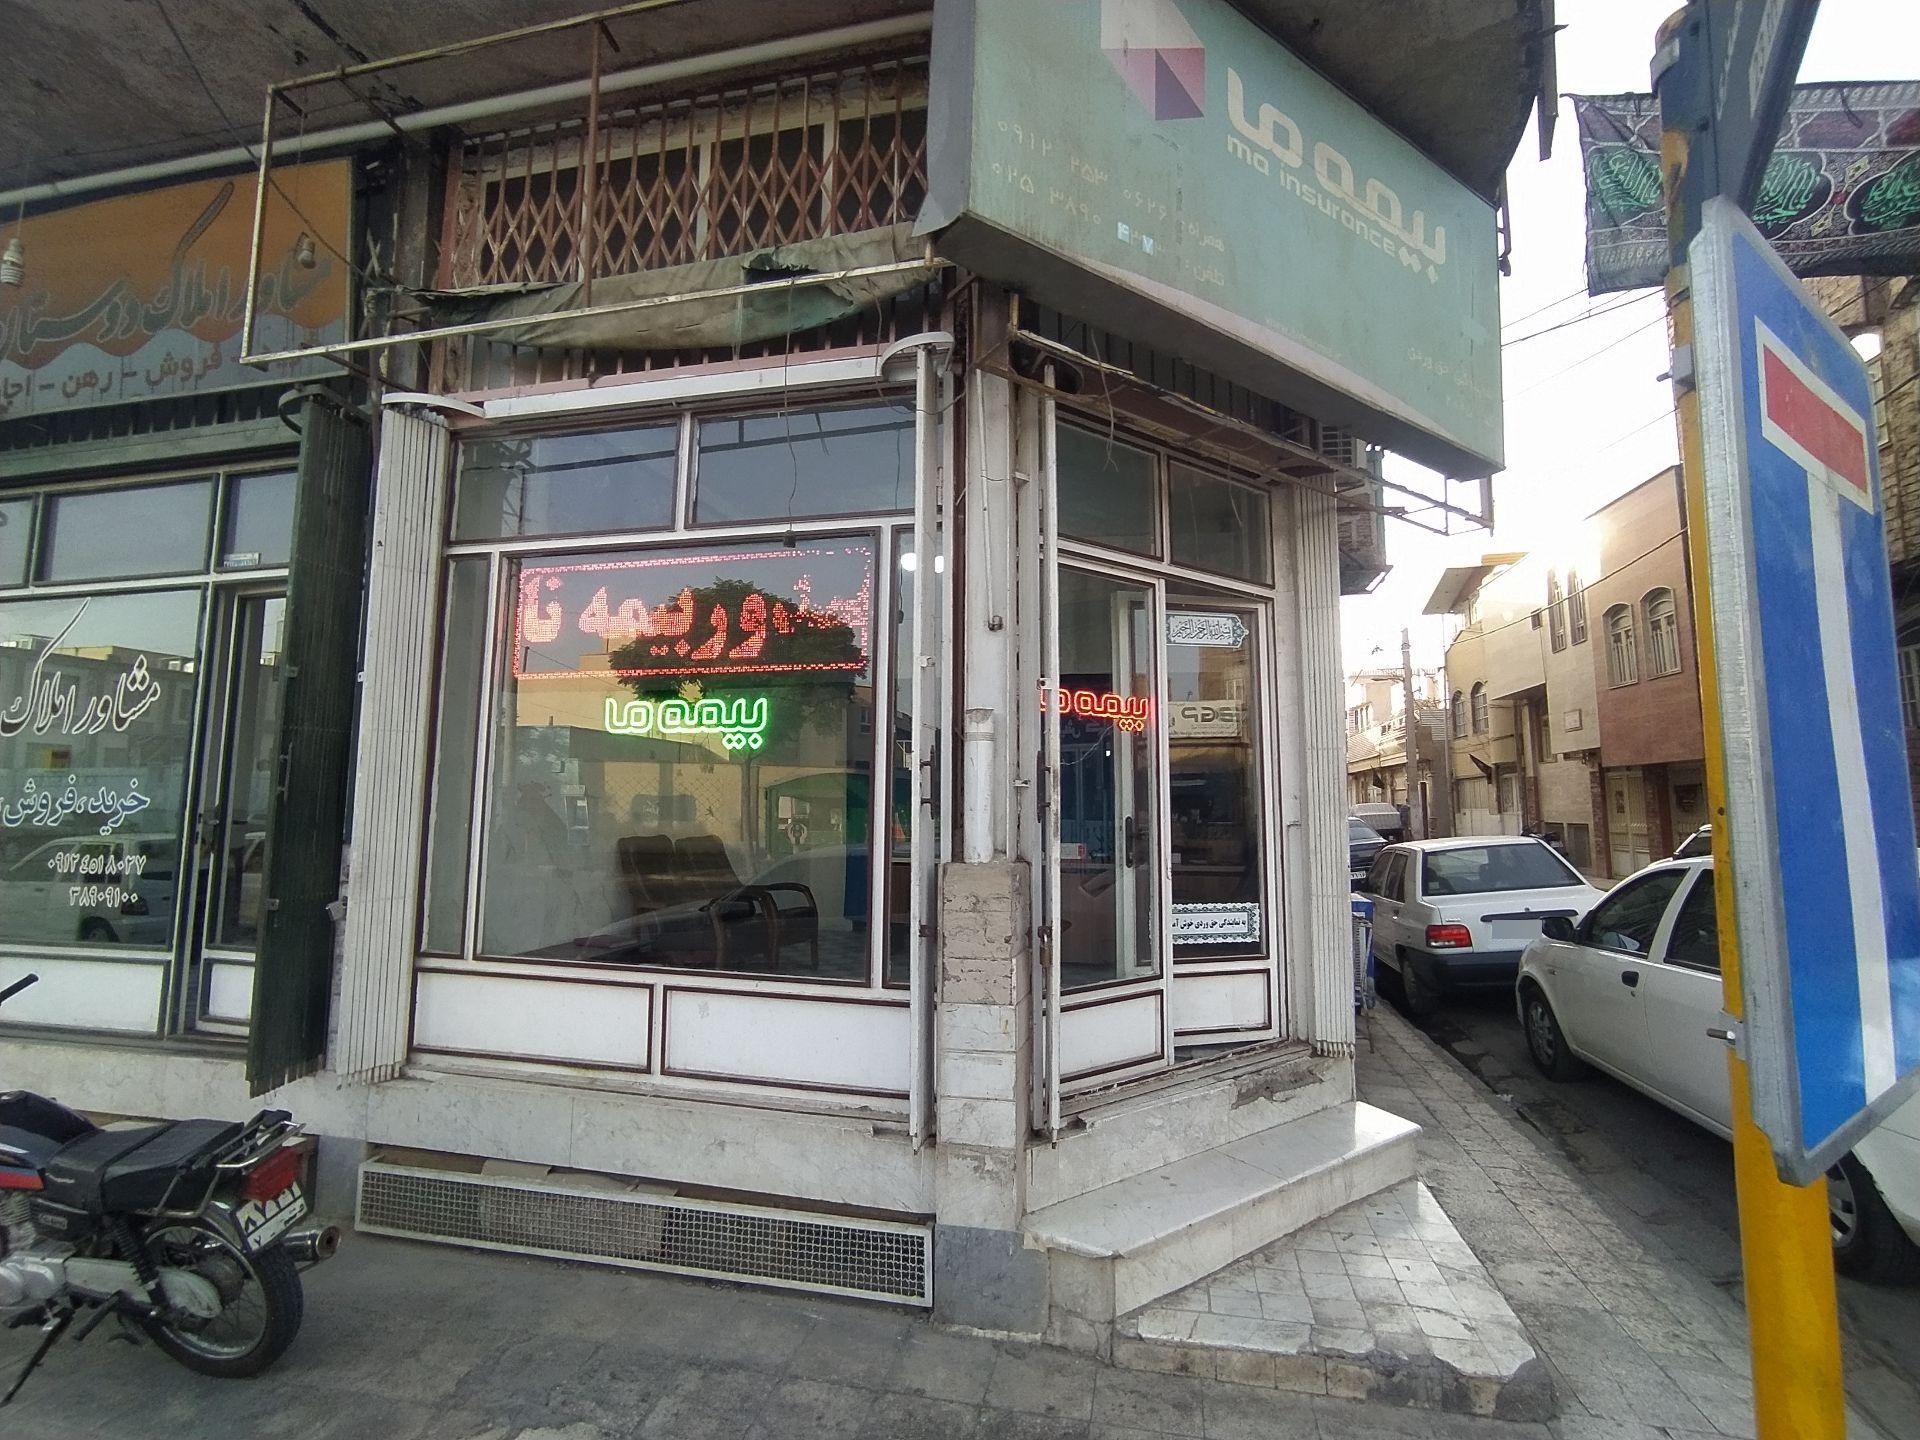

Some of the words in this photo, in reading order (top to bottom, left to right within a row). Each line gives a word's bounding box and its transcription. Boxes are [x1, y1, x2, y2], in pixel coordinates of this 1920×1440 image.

[1227, 67, 1303, 168] ما
[1227, 134, 1270, 176] ma
[1279, 161, 1396, 258] insurance
[1314, 141, 1446, 284] بیمه
[62, 368, 113, 399] رهن
[578, 584, 695, 657] بیمه
[0, 596, 91, 737] املاک
[72, 654, 162, 735] مشاور
[604, 697, 655, 734] ما
[655, 697, 767, 750] بیمه
[1073, 689, 1148, 732] بیمه
[69, 885, 139, 908] ۳۸۹۰۹۱۰۰
[1209, 918, 1218, 929] حق
